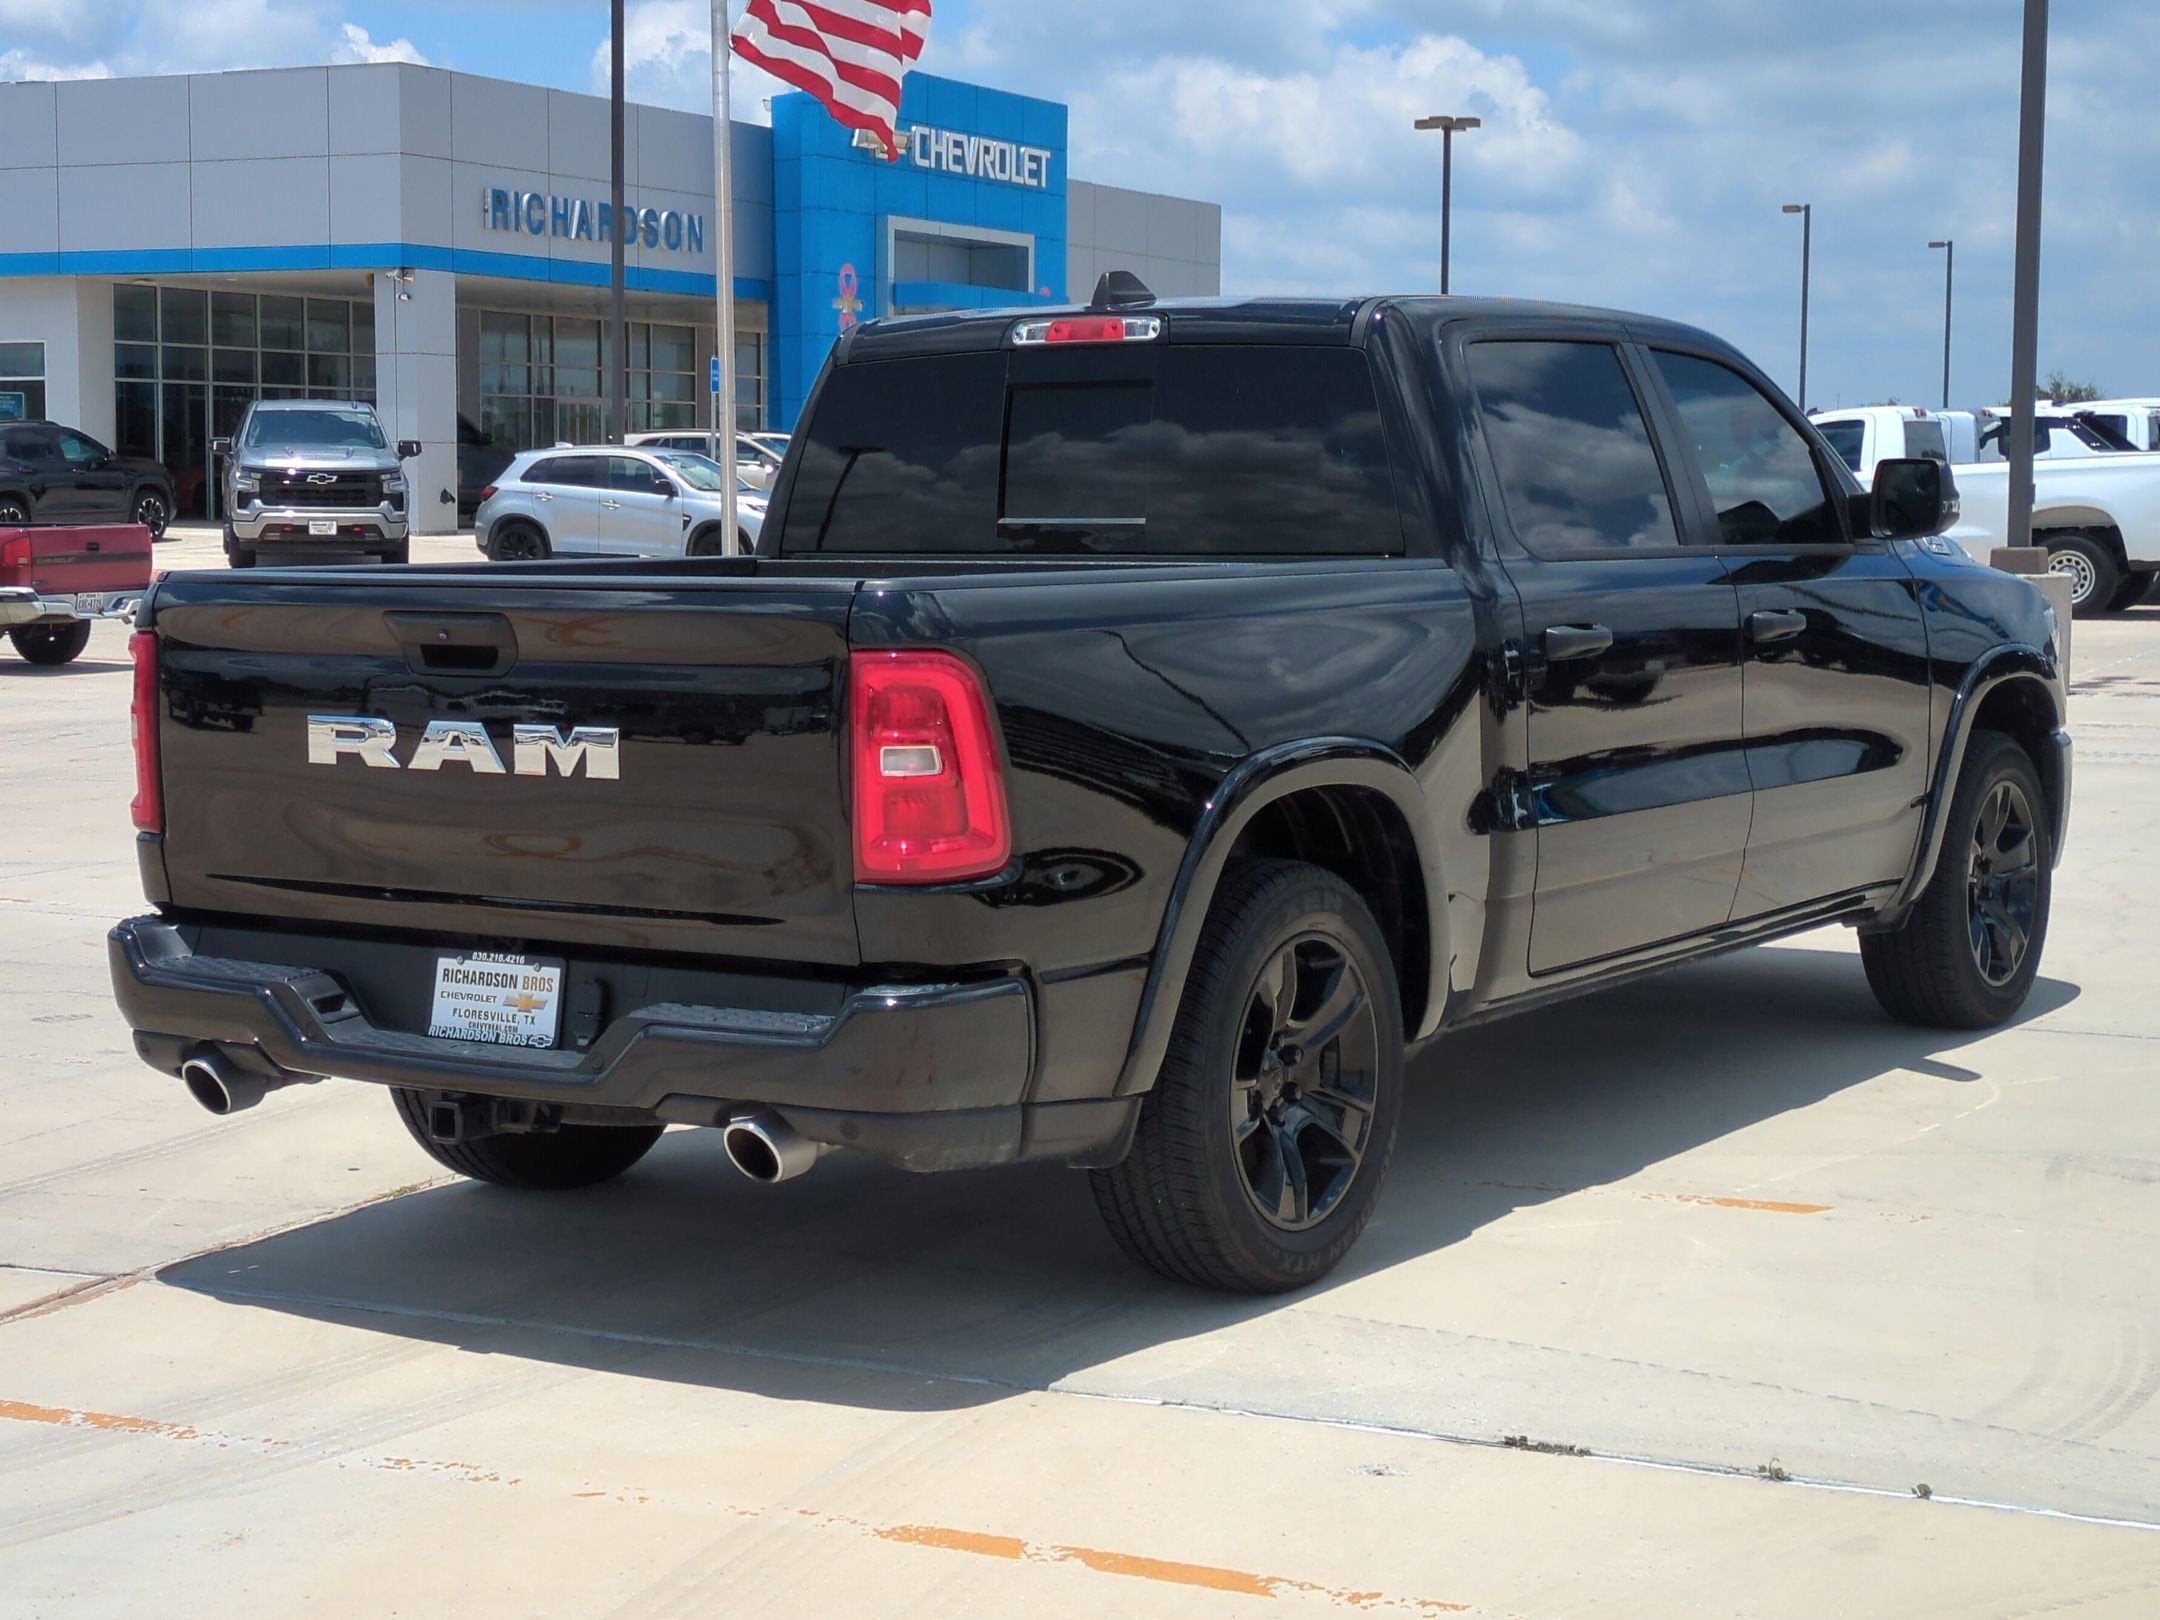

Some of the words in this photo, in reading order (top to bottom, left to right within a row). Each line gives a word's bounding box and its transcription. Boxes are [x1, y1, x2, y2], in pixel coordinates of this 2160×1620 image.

[911, 125, 1050, 188] CHEVROLET
[487, 188, 703, 253] RICHARDSON
[307, 714, 620, 779] RAM
[442, 967, 518, 990] RICHARDSON
[522, 975, 554, 993] BROS
[440, 990, 498, 1003] CHEVROLET
[452, 1007, 520, 1025] FLORESVILLE,
[524, 1014, 536, 1026] TX
[428, 1024, 497, 1043] RICHARDSON
[498, 1031, 529, 1046] BROS
